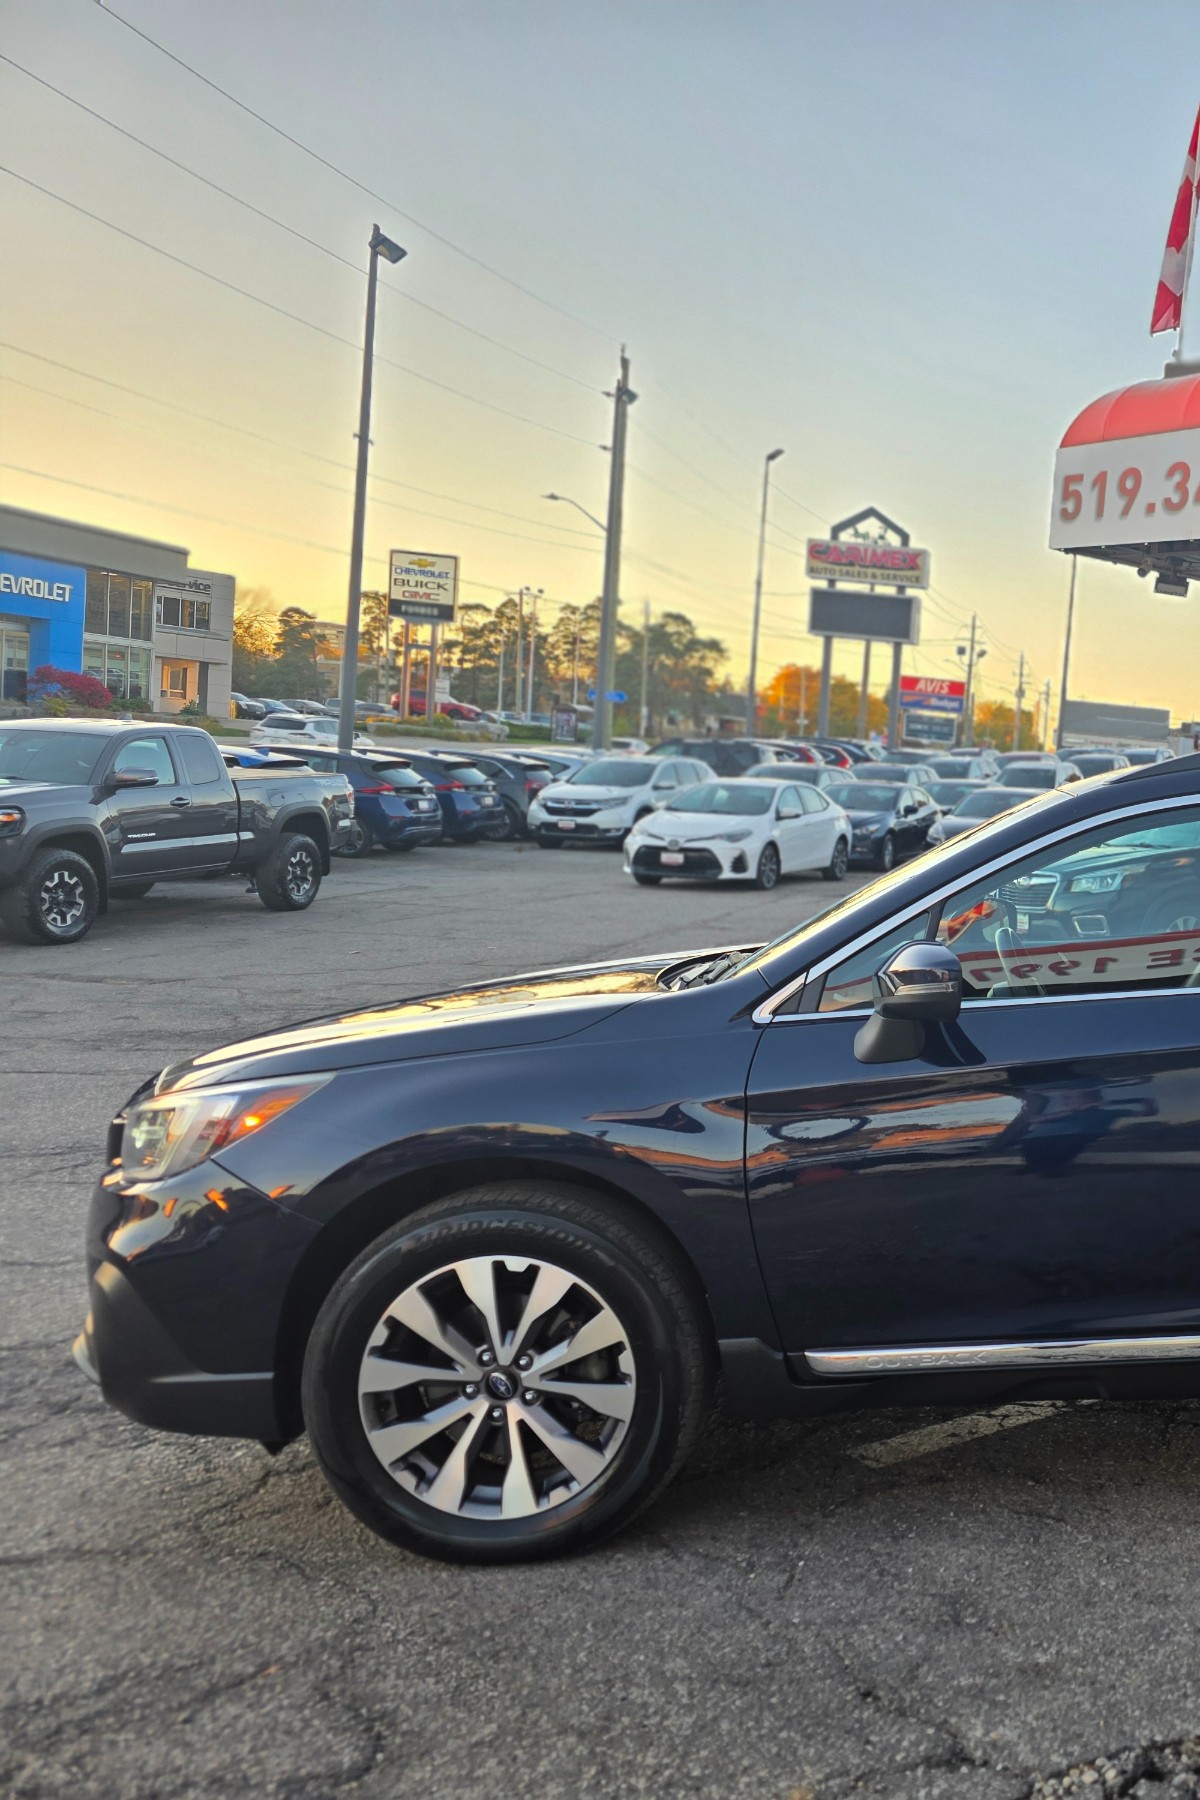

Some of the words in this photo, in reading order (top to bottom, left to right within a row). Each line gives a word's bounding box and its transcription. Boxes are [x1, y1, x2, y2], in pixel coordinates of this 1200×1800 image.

[809, 543, 923, 571] CARIMEX
[394, 567, 451, 579] CHEVROLET
[810, 566, 836, 577] AUTO
[839, 569, 869, 580] SALES
[881, 573, 921, 584] SERVICE
[394, 578, 449, 592] BUICK
[402, 590, 440, 601] GMC
[915, 679, 951, 694] AVIS
[865, 1351, 987, 1369] OUTBACK
